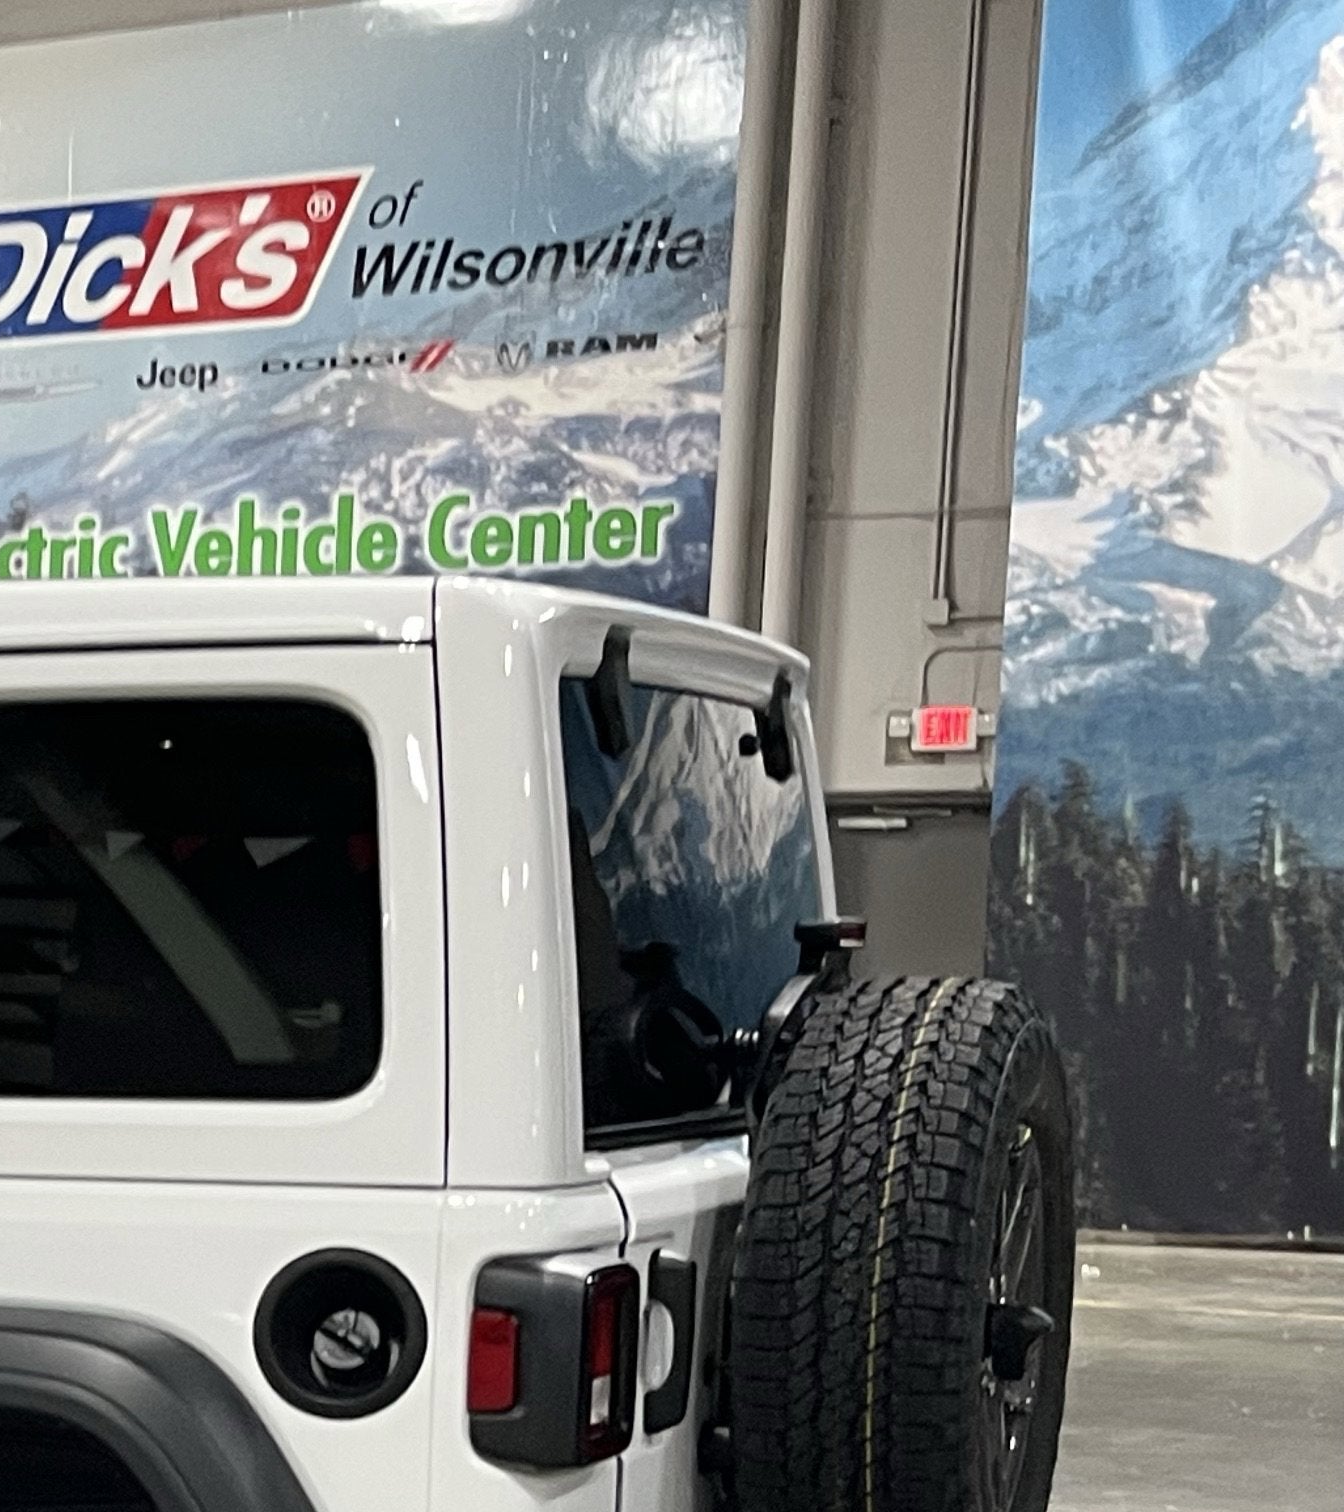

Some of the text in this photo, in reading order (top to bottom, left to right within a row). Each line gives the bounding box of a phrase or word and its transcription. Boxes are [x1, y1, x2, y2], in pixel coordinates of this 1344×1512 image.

[369, 179, 424, 230] of
[352, 214, 705, 299] Wilsonville
[136, 357, 219, 392] Jeep
[545, 332, 659, 361] RAM
[151, 494, 398, 578] Vehicle
[428, 494, 675, 570] Center
[924, 711, 969, 745] EXIT
